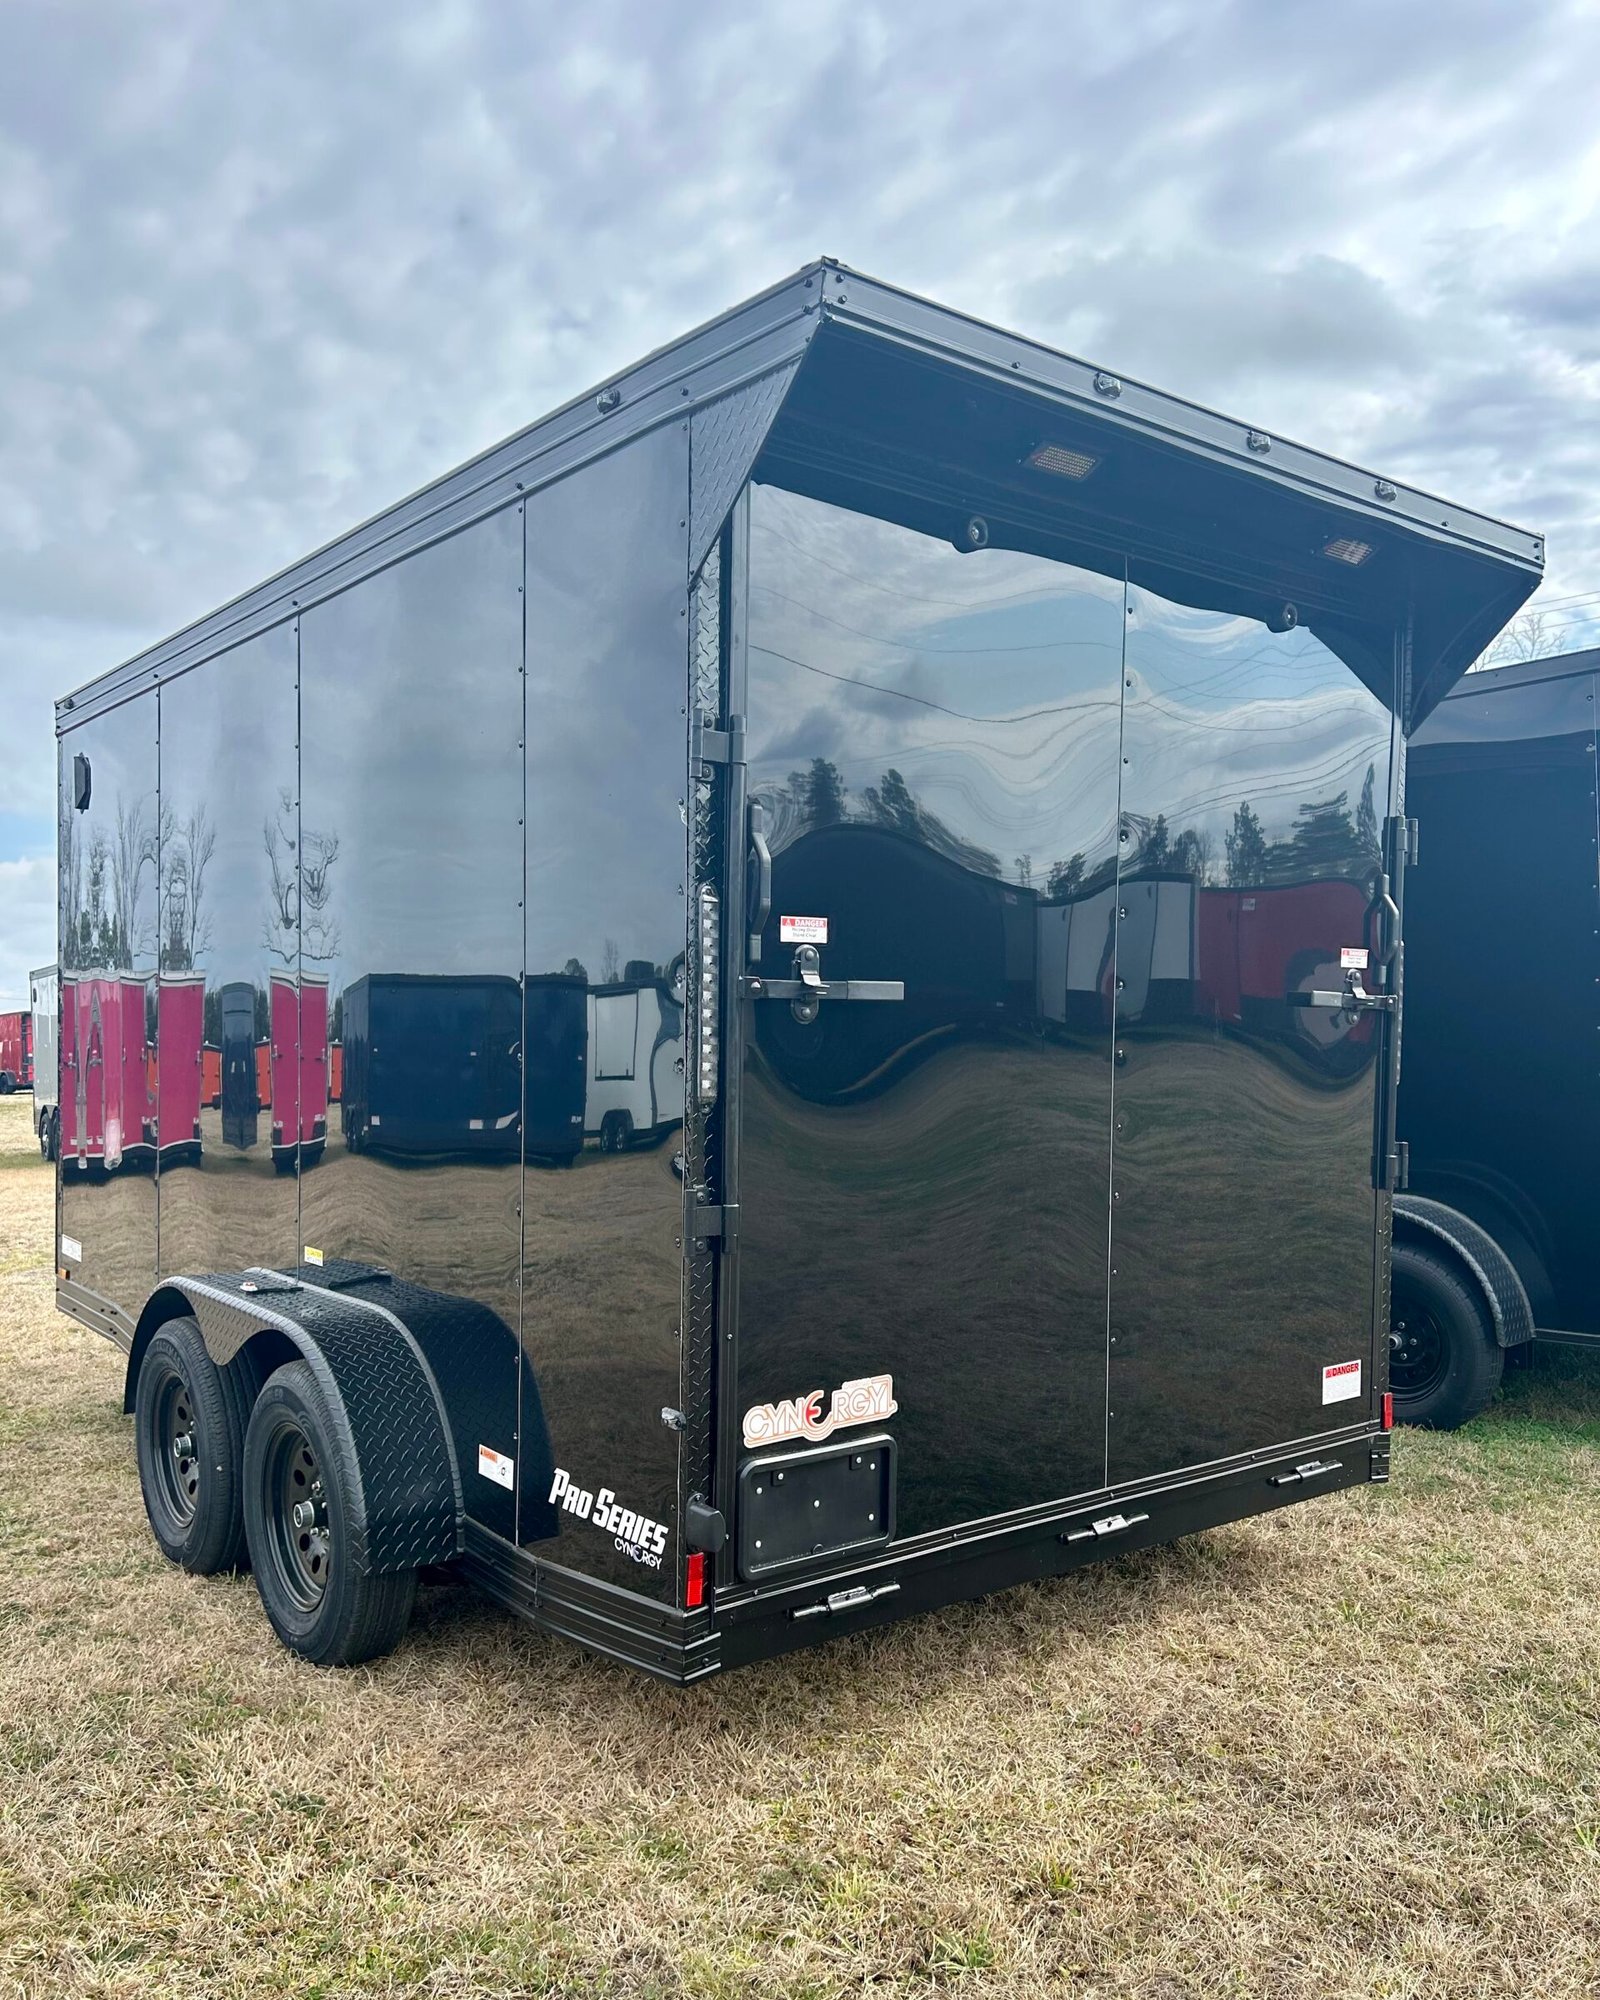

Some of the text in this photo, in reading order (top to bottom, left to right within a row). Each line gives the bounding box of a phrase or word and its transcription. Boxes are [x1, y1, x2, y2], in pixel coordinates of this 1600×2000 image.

[795, 919, 826, 928] DANGER
[1332, 1362, 1359, 1377] DANGER
[614, 1537, 662, 1570] CYNERGY
